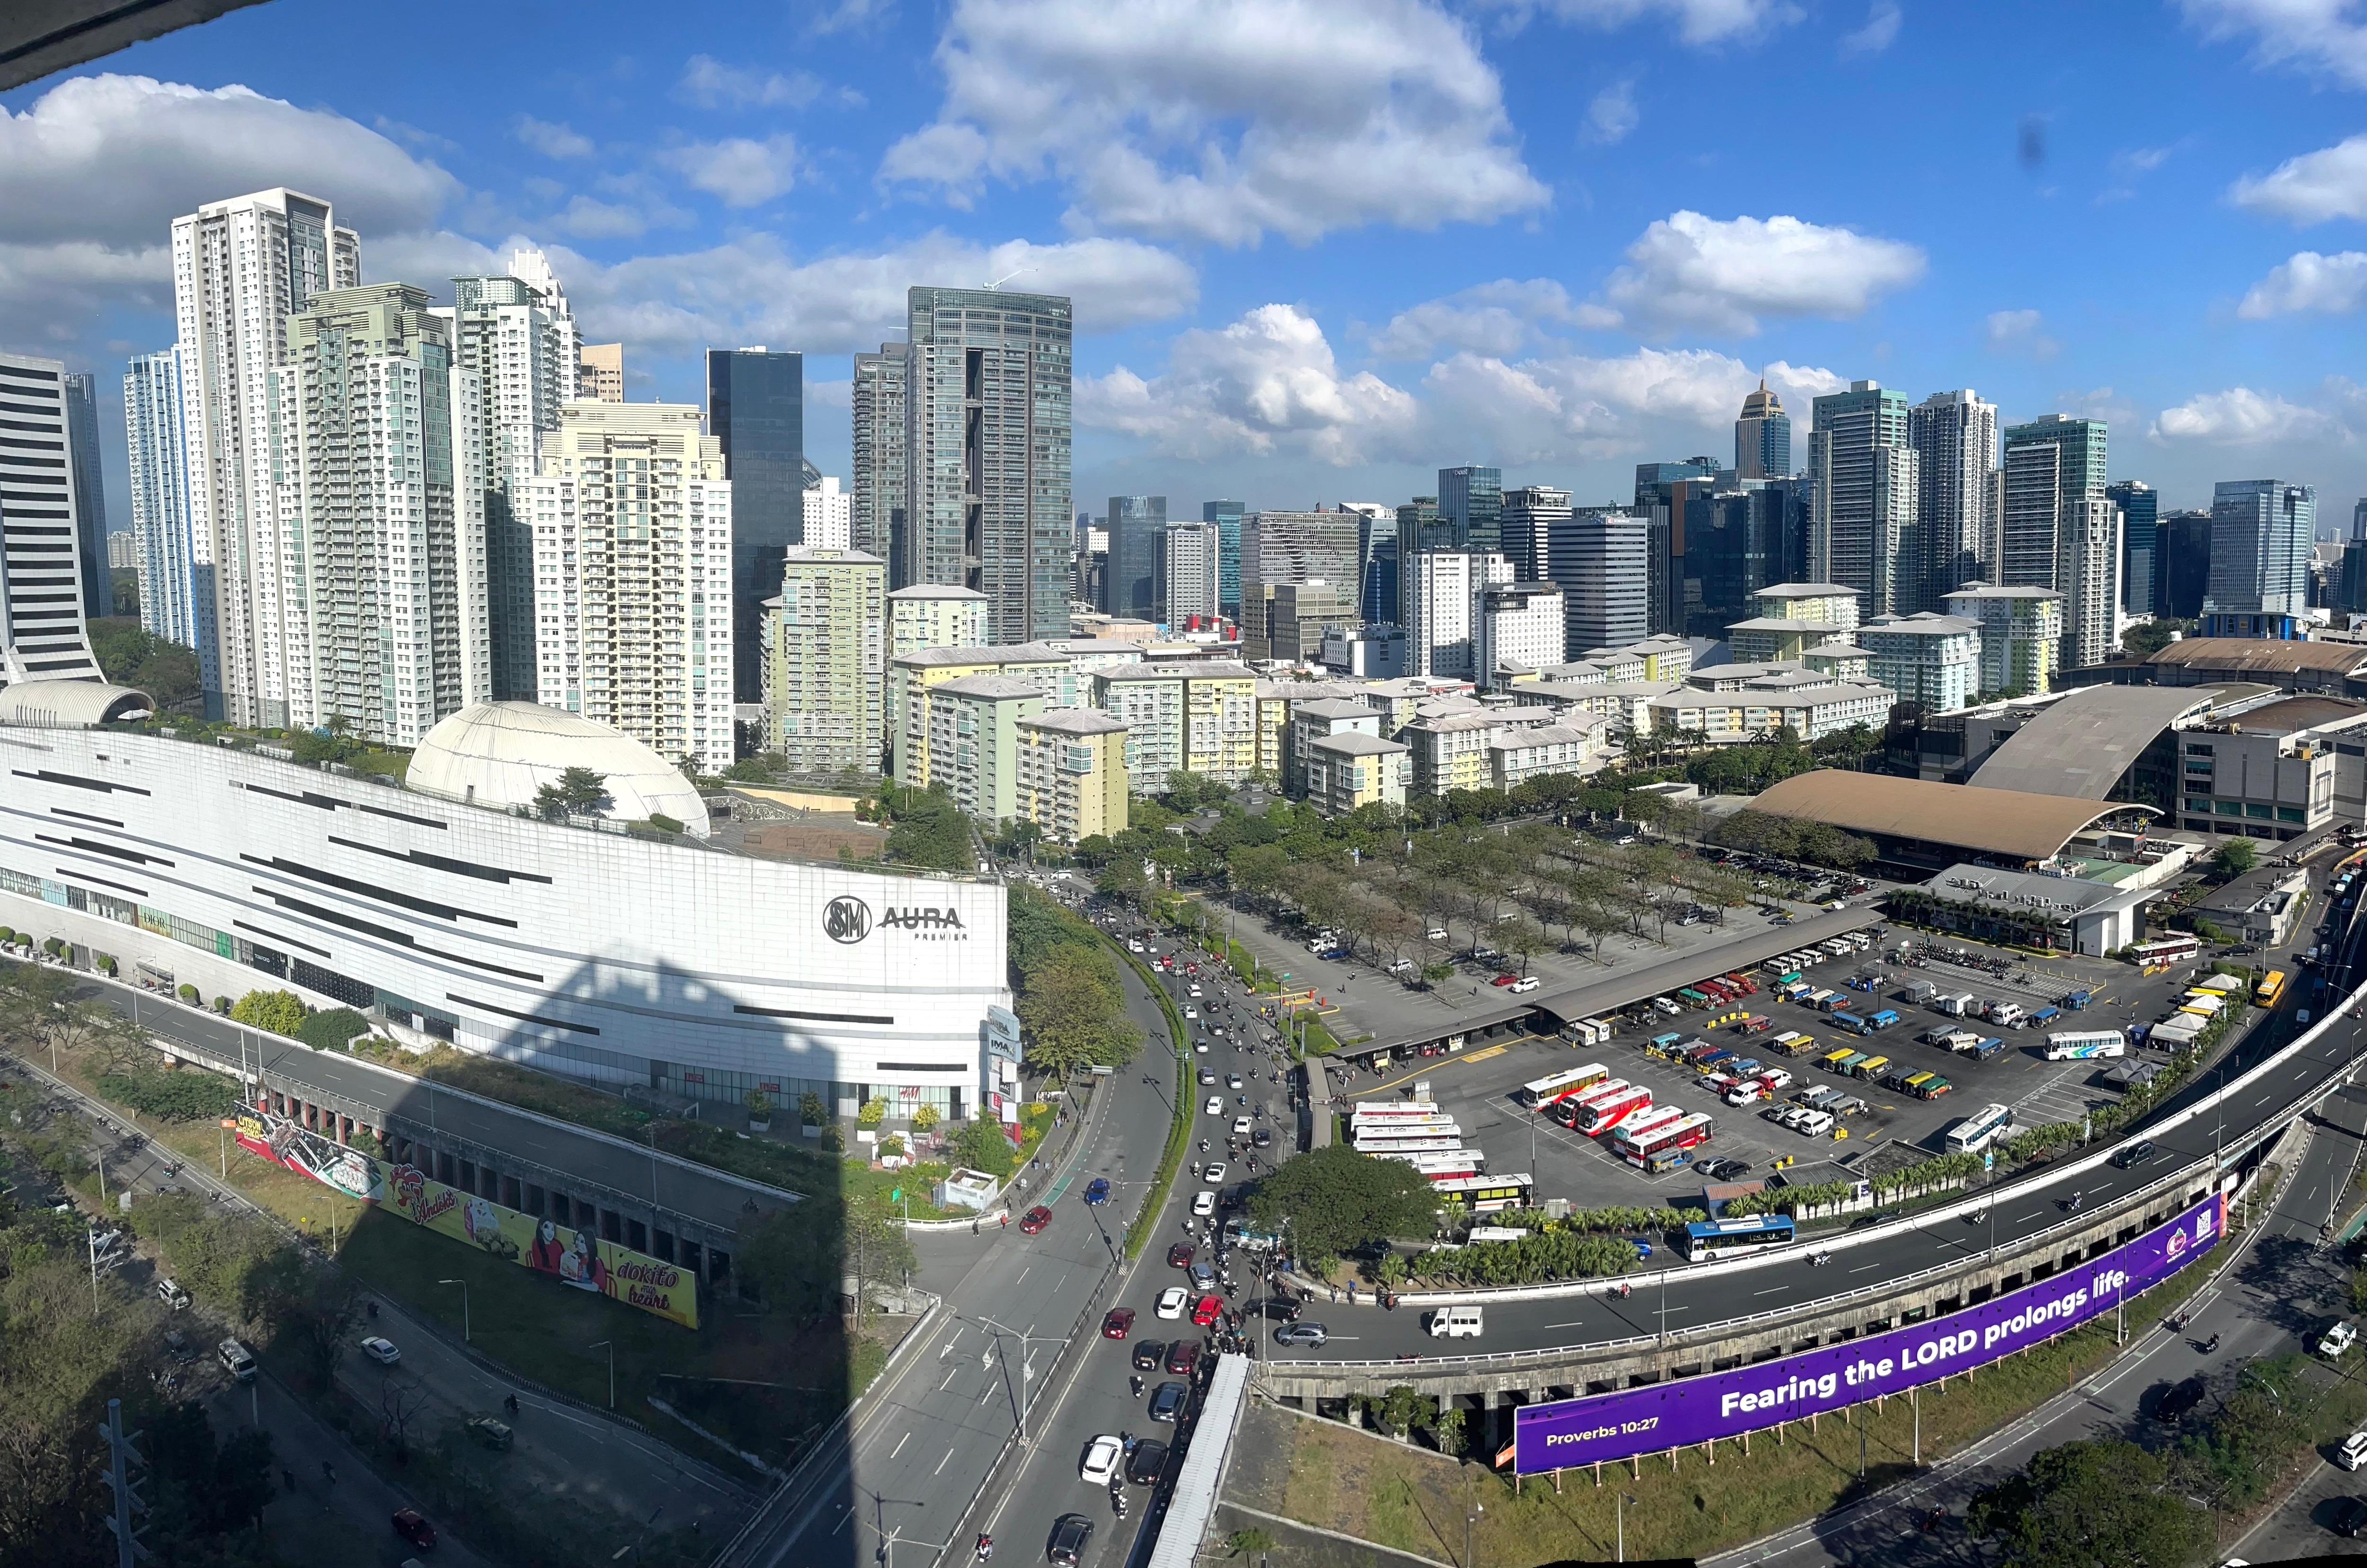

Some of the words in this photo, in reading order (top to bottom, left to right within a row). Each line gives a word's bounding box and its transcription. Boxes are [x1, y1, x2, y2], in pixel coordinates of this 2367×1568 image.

[144, 912, 166, 929] DIOR
[876, 907, 966, 930] AURA
[914, 932, 968, 941] PREMIER
[991, 1039, 1014, 1054] IMAX
[243, 1126, 260, 1140] BAKA
[1721, 1248, 1737, 1257] BGC
[617, 1260, 678, 1287] dokito
[628, 1284, 669, 1311] heart
[641, 1285, 656, 1297] my
[1721, 1373, 1837, 1417] Fearing
[1844, 1358, 1894, 1385] the
[1902, 1329, 1977, 1371] LORD
[1984, 1287, 2087, 1349] prolongs
[2093, 1269, 2130, 1298] life.
[1547, 1426, 1617, 1446] Proverbs
[1621, 1417, 1659, 1435] 10:27
